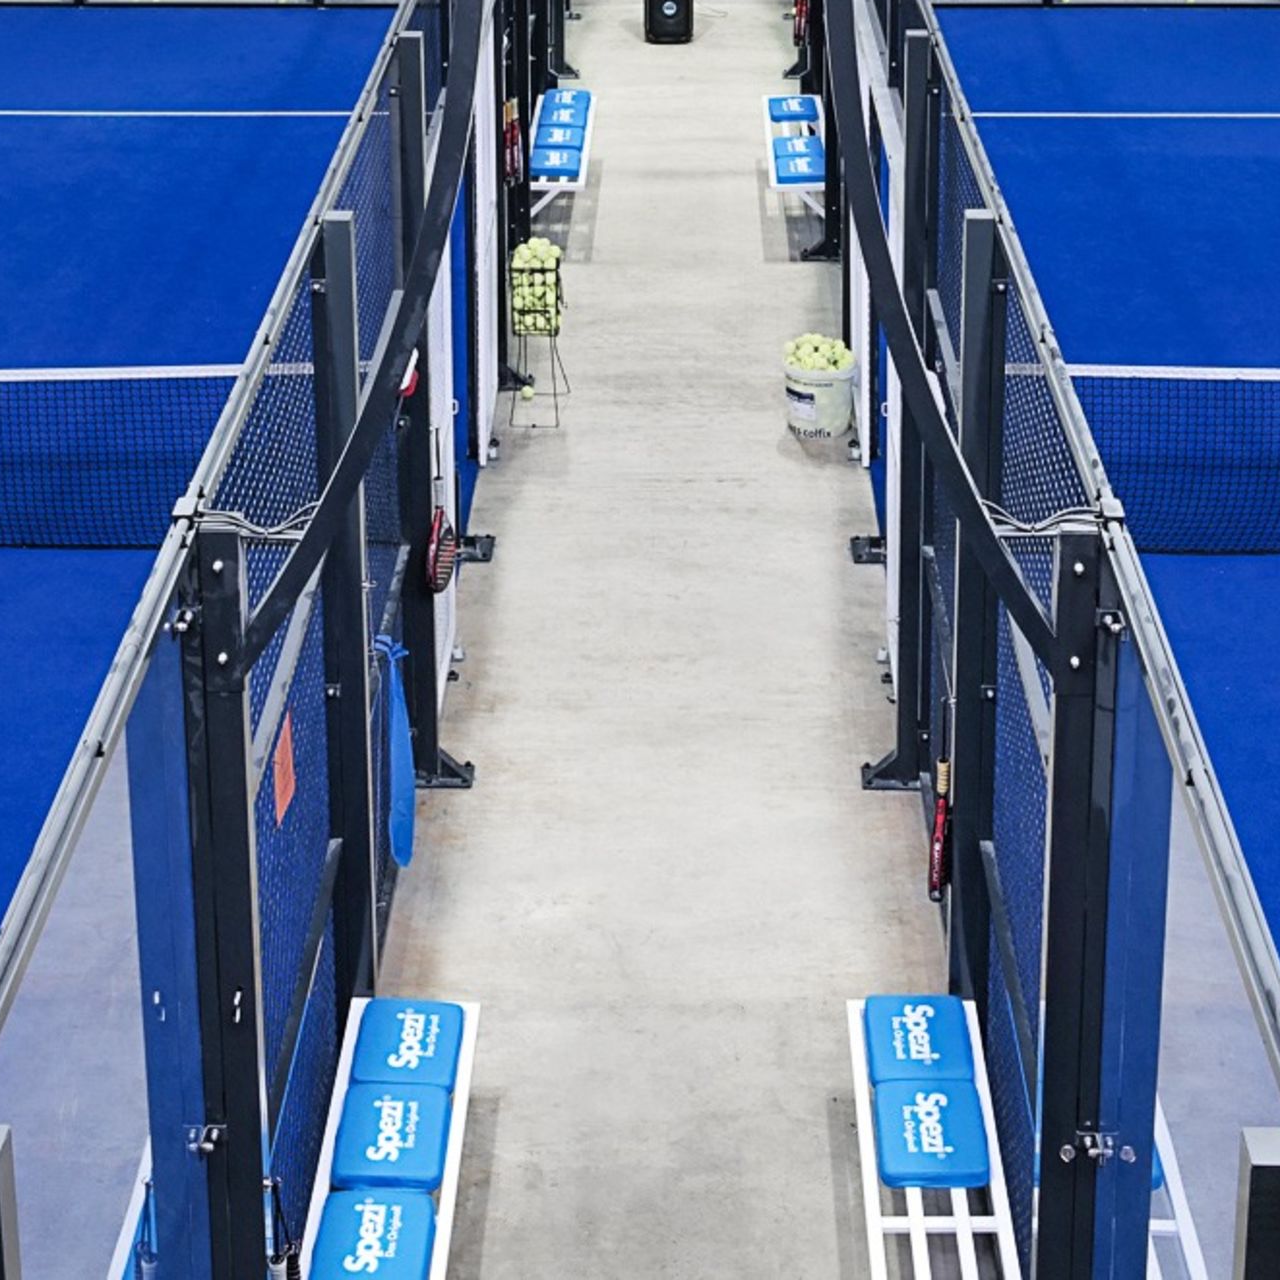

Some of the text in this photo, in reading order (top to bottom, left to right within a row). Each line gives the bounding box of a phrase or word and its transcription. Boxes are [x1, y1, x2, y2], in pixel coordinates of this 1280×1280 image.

[387, 1013, 427, 1069] Spezi
[902, 1004, 941, 1060] Spezi
[365, 1100, 404, 1162] Spezi
[913, 1092, 954, 1153] Spezi
[343, 1204, 386, 1273] Spezi
